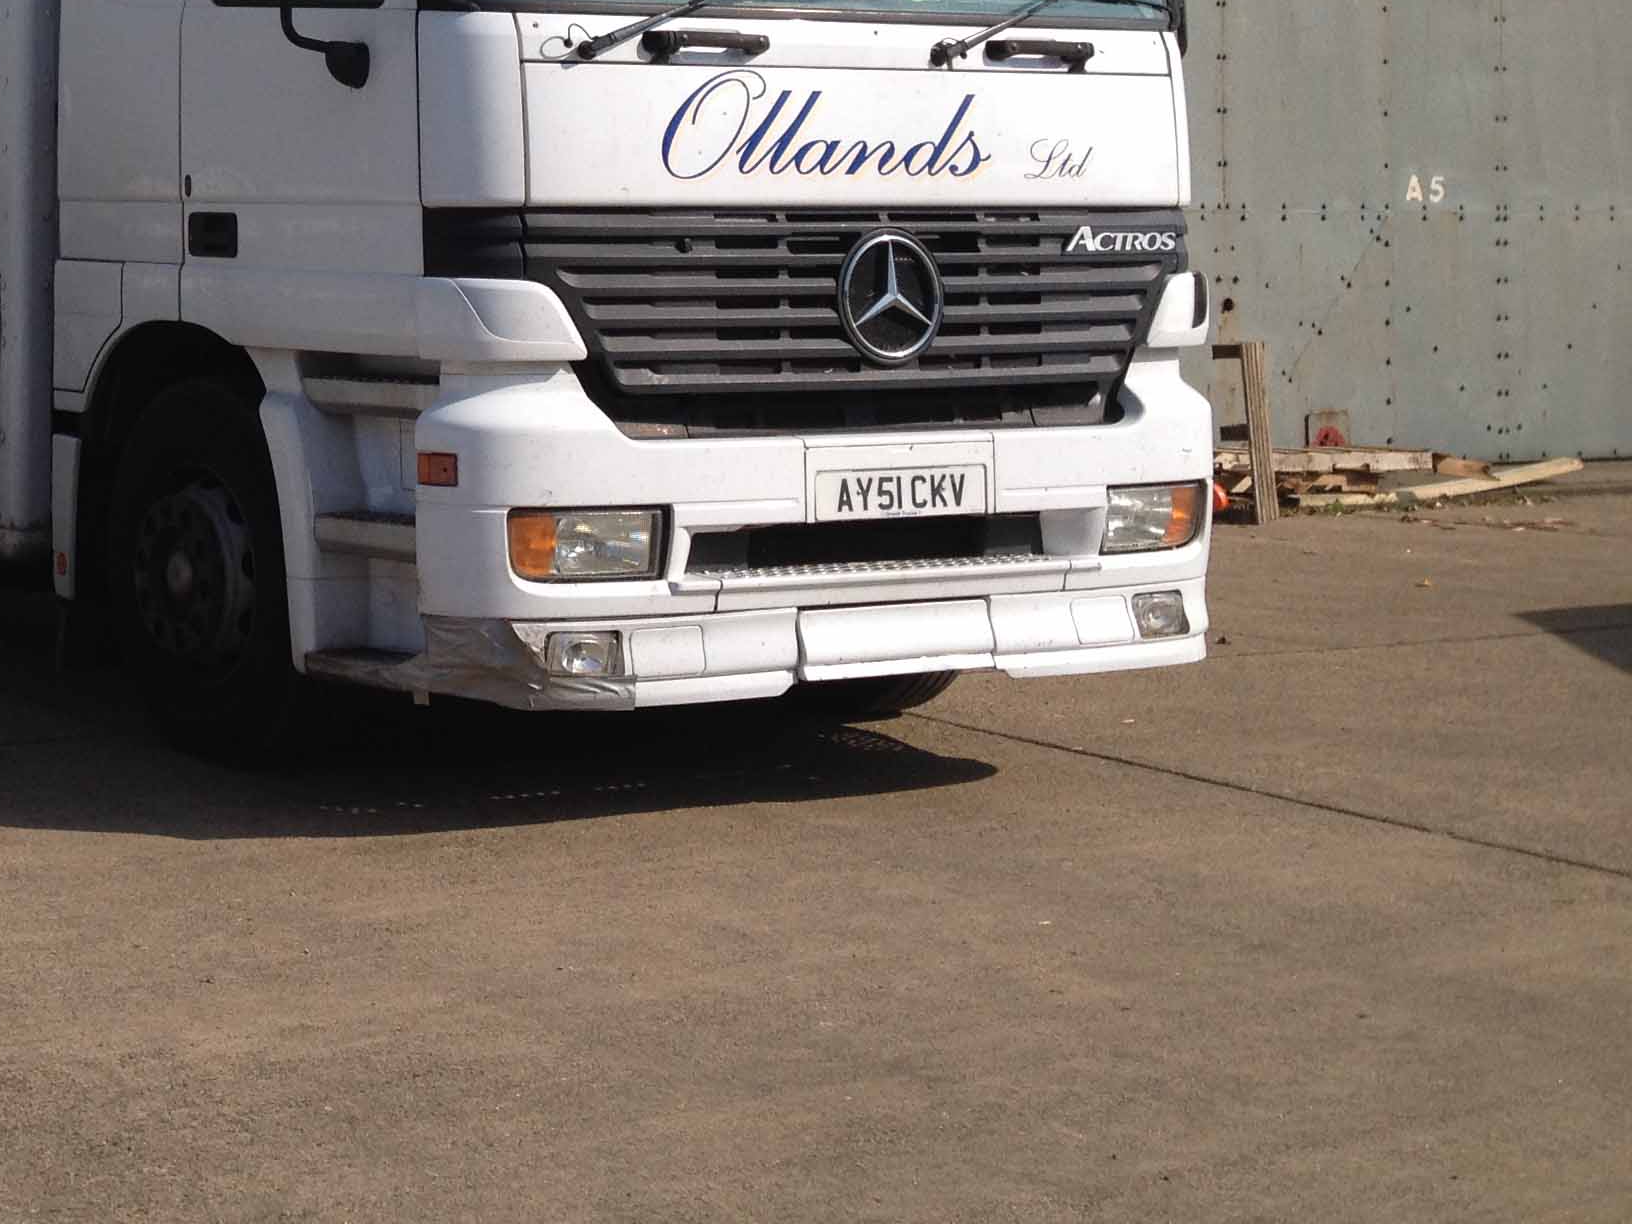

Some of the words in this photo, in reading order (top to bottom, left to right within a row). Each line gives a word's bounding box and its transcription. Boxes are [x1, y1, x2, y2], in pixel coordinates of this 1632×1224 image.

[662, 69, 991, 180] Ollands
[1024, 138, 1093, 180] Ltd
[1066, 225, 1176, 251] ACTROS
[837, 476, 903, 512] AY51
[911, 473, 965, 509] CKV
